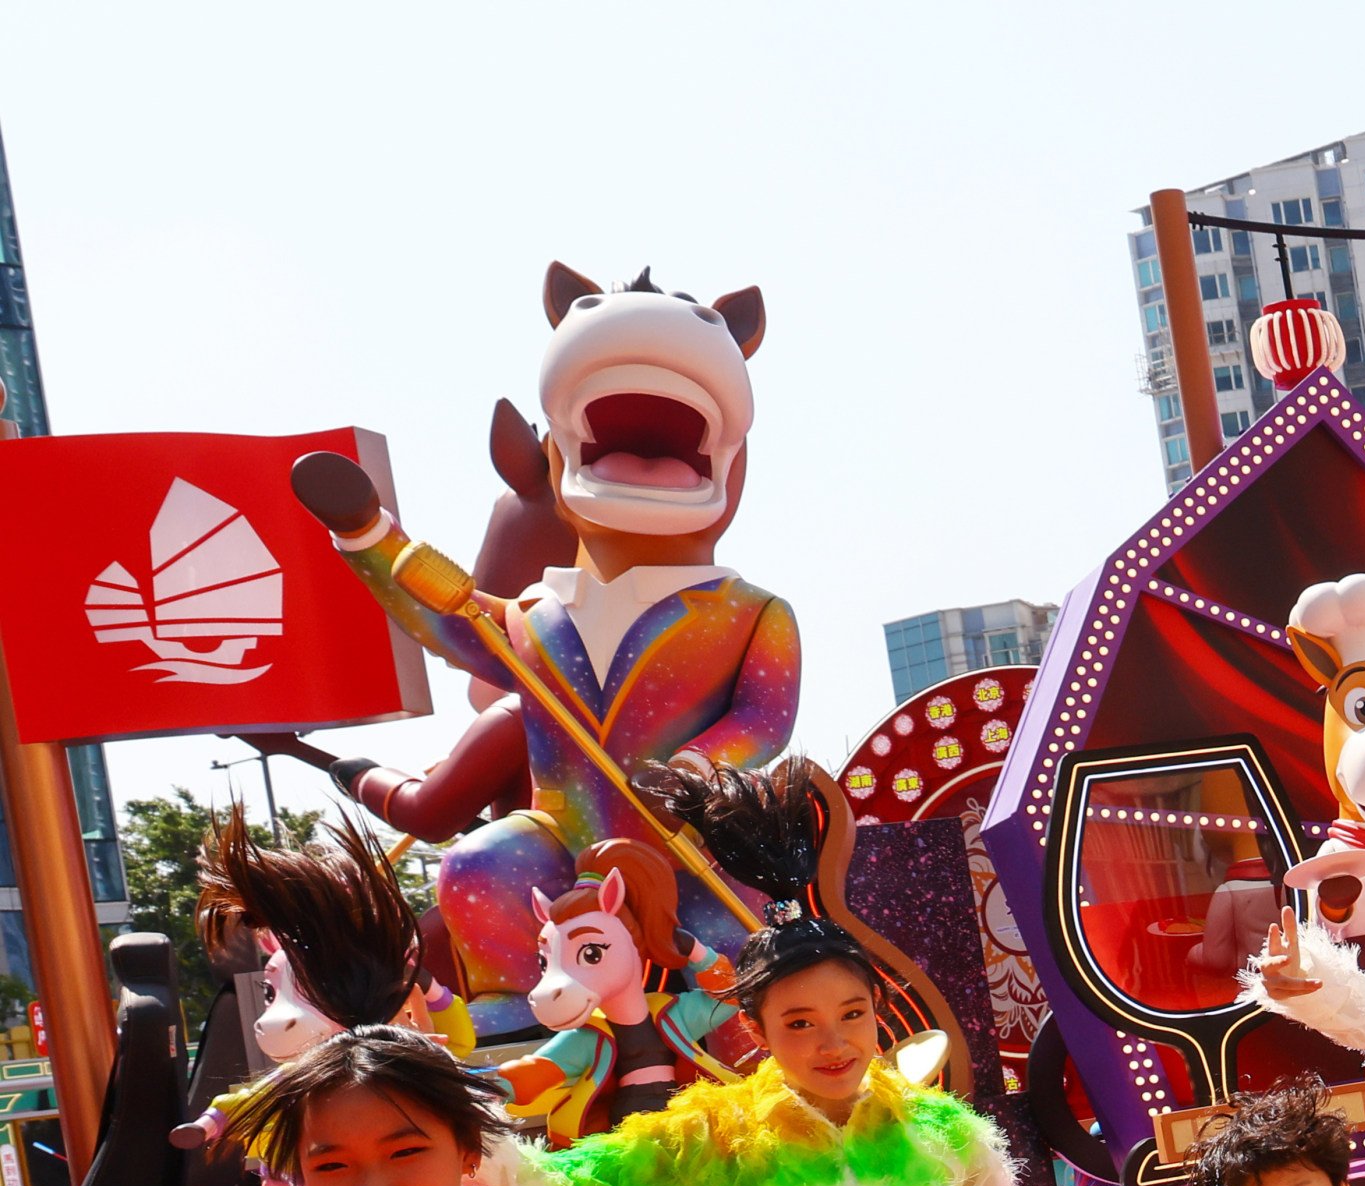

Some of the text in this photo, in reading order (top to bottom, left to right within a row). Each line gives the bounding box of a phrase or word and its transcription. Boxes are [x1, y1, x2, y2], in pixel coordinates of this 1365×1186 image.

[976, 686, 1001, 701] 北京
[929, 704, 954, 719] 香港
[985, 727, 1009, 743] 上海
